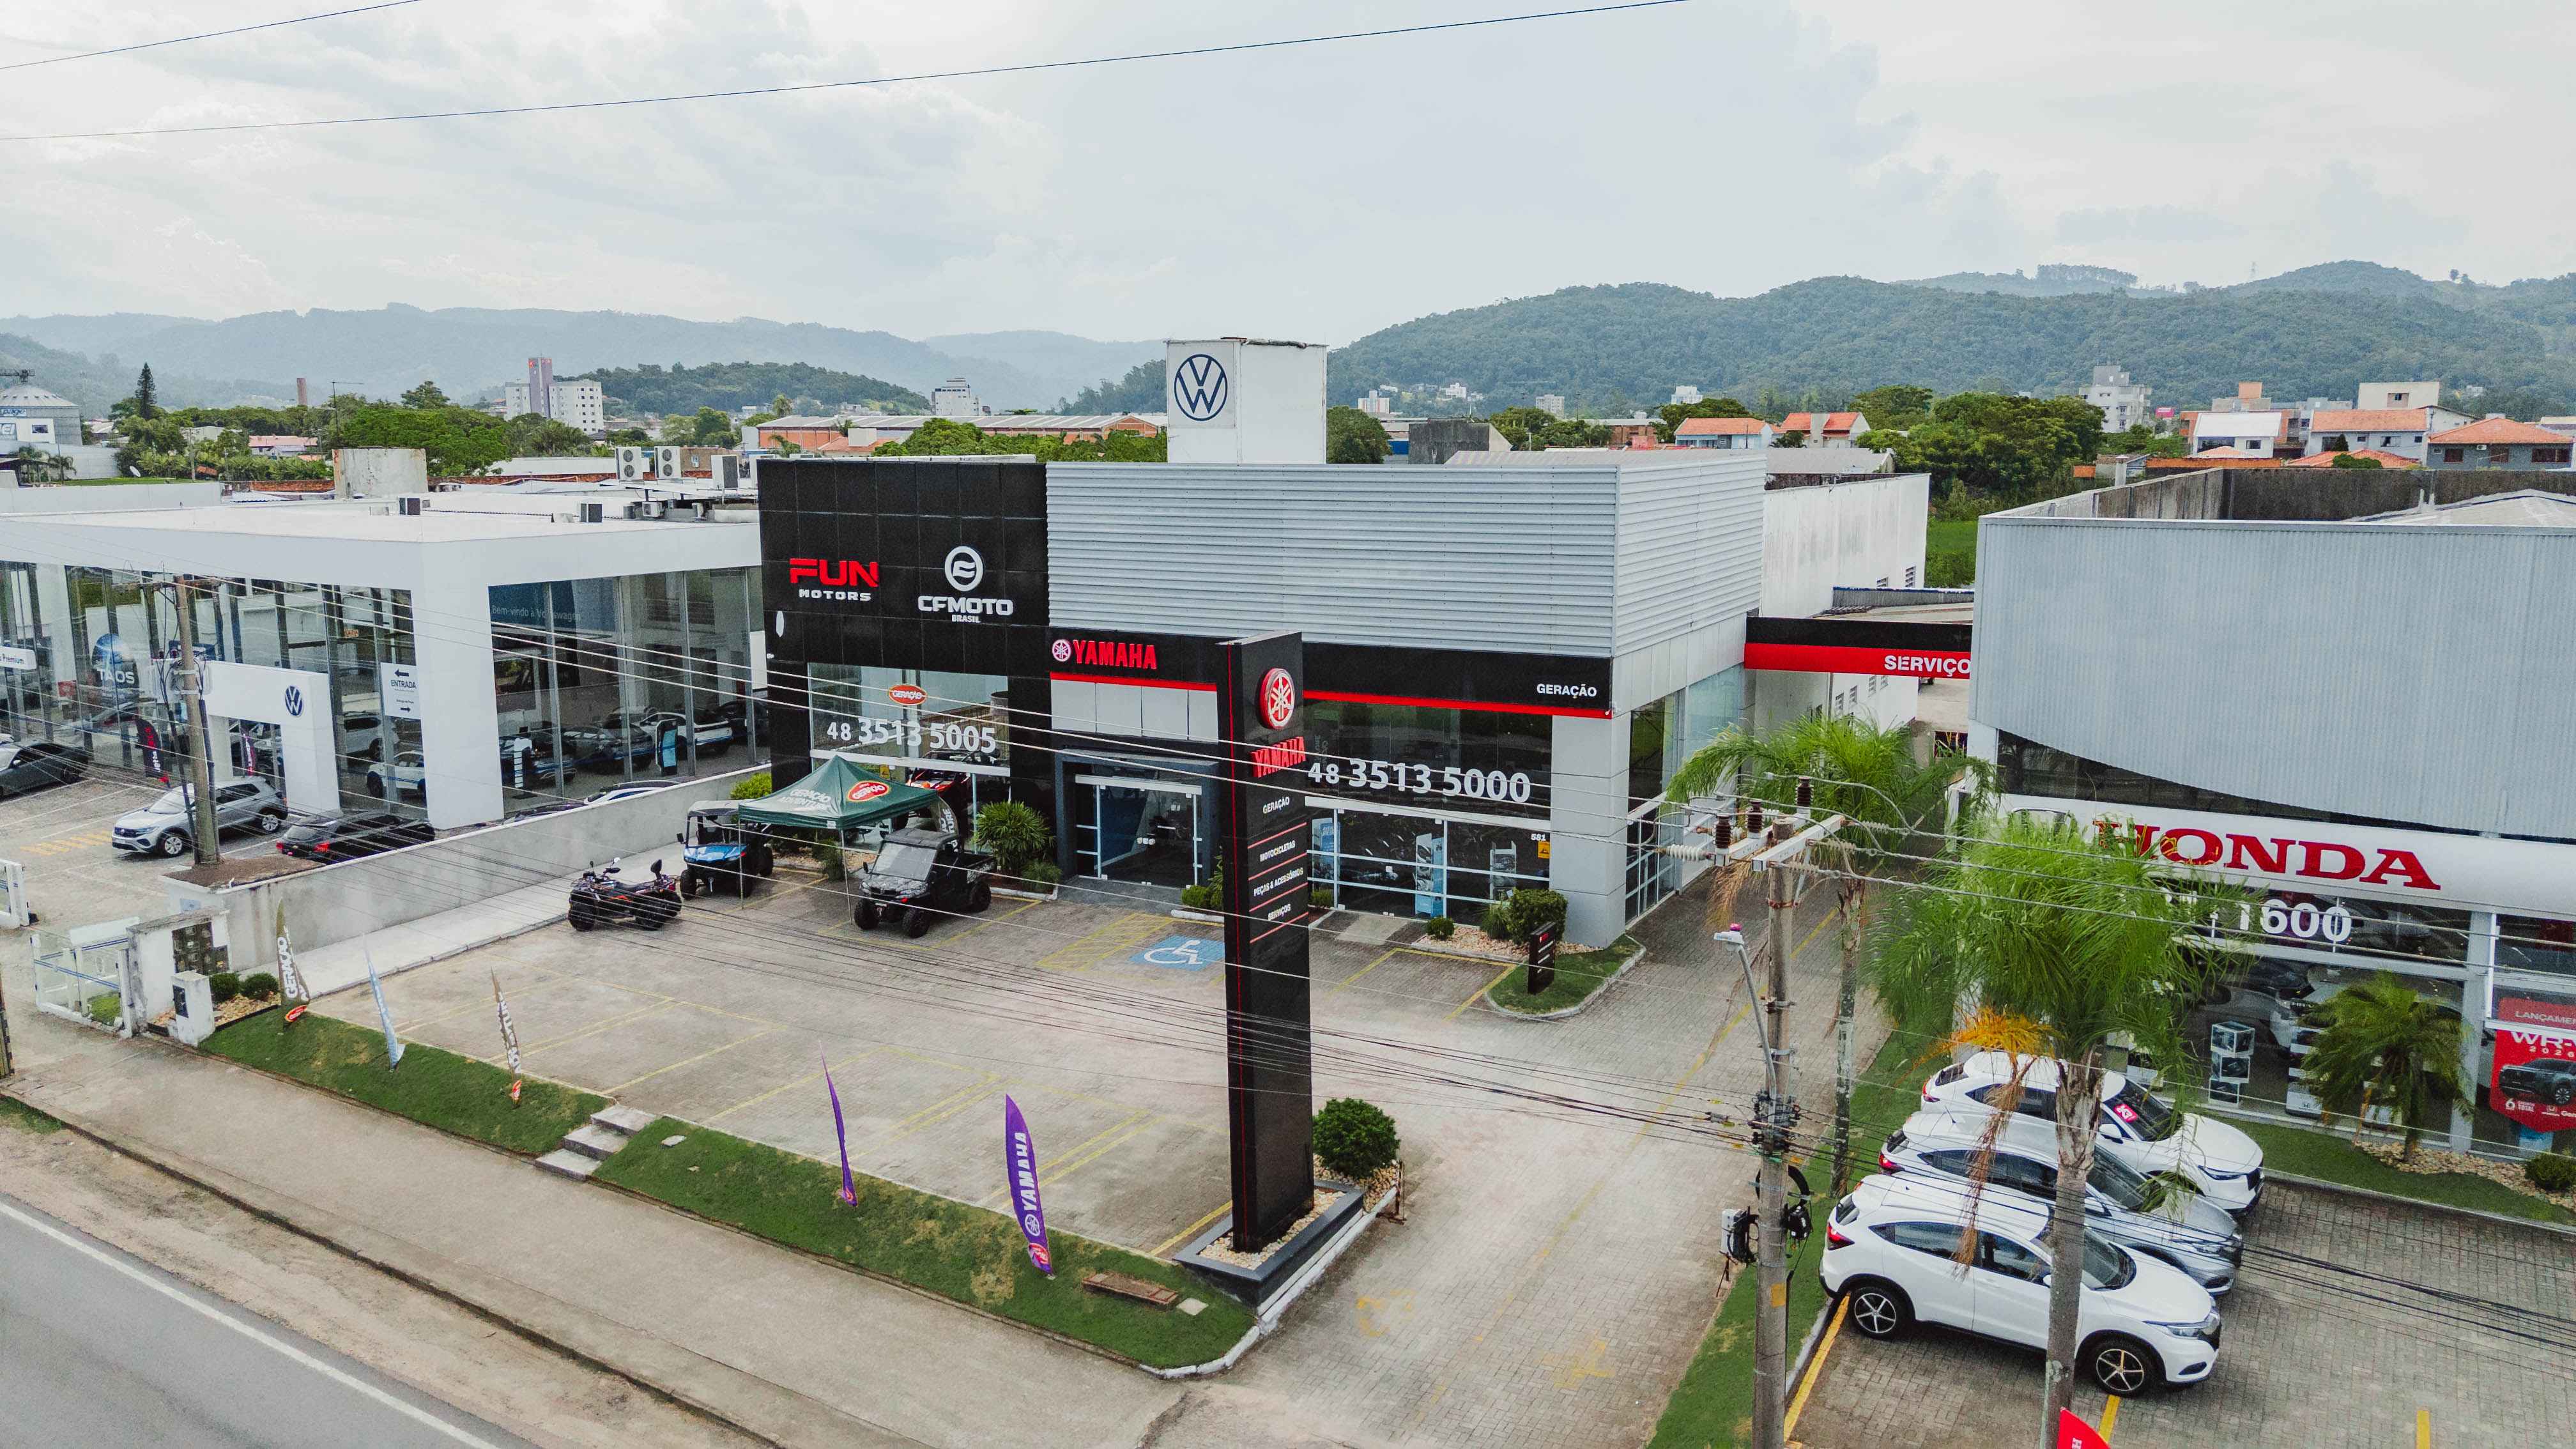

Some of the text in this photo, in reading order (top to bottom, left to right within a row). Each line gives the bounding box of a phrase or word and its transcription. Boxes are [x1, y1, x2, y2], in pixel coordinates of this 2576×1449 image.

[789, 558, 878, 587] FUN
[799, 589, 871, 601] MOTORS
[917, 595, 1014, 616] CFMOTO
[536, 608, 581, 623] Voswagen
[951, 615, 981, 624] BRASIL
[1073, 639, 1158, 670] YAMAHA
[1884, 655, 1972, 677] SERVIÇO
[391, 679, 417, 689] ENTRADA
[1537, 684, 1597, 699] GERAÇÃO
[827, 716, 997, 753] 48 3513 5005
[1252, 736, 1307, 778] YAMAHA
[1308, 758, 1531, 804] 48 3513 5000
[1262, 796, 1290, 814] GERAÇÃO
[1531, 833, 1547, 841] 581
[1260, 840, 1296, 862] MOTOCICLETAS
[1254, 882, 1270, 896] PEÇAS
[1015, 1132, 1038, 1211] YAMAHA
